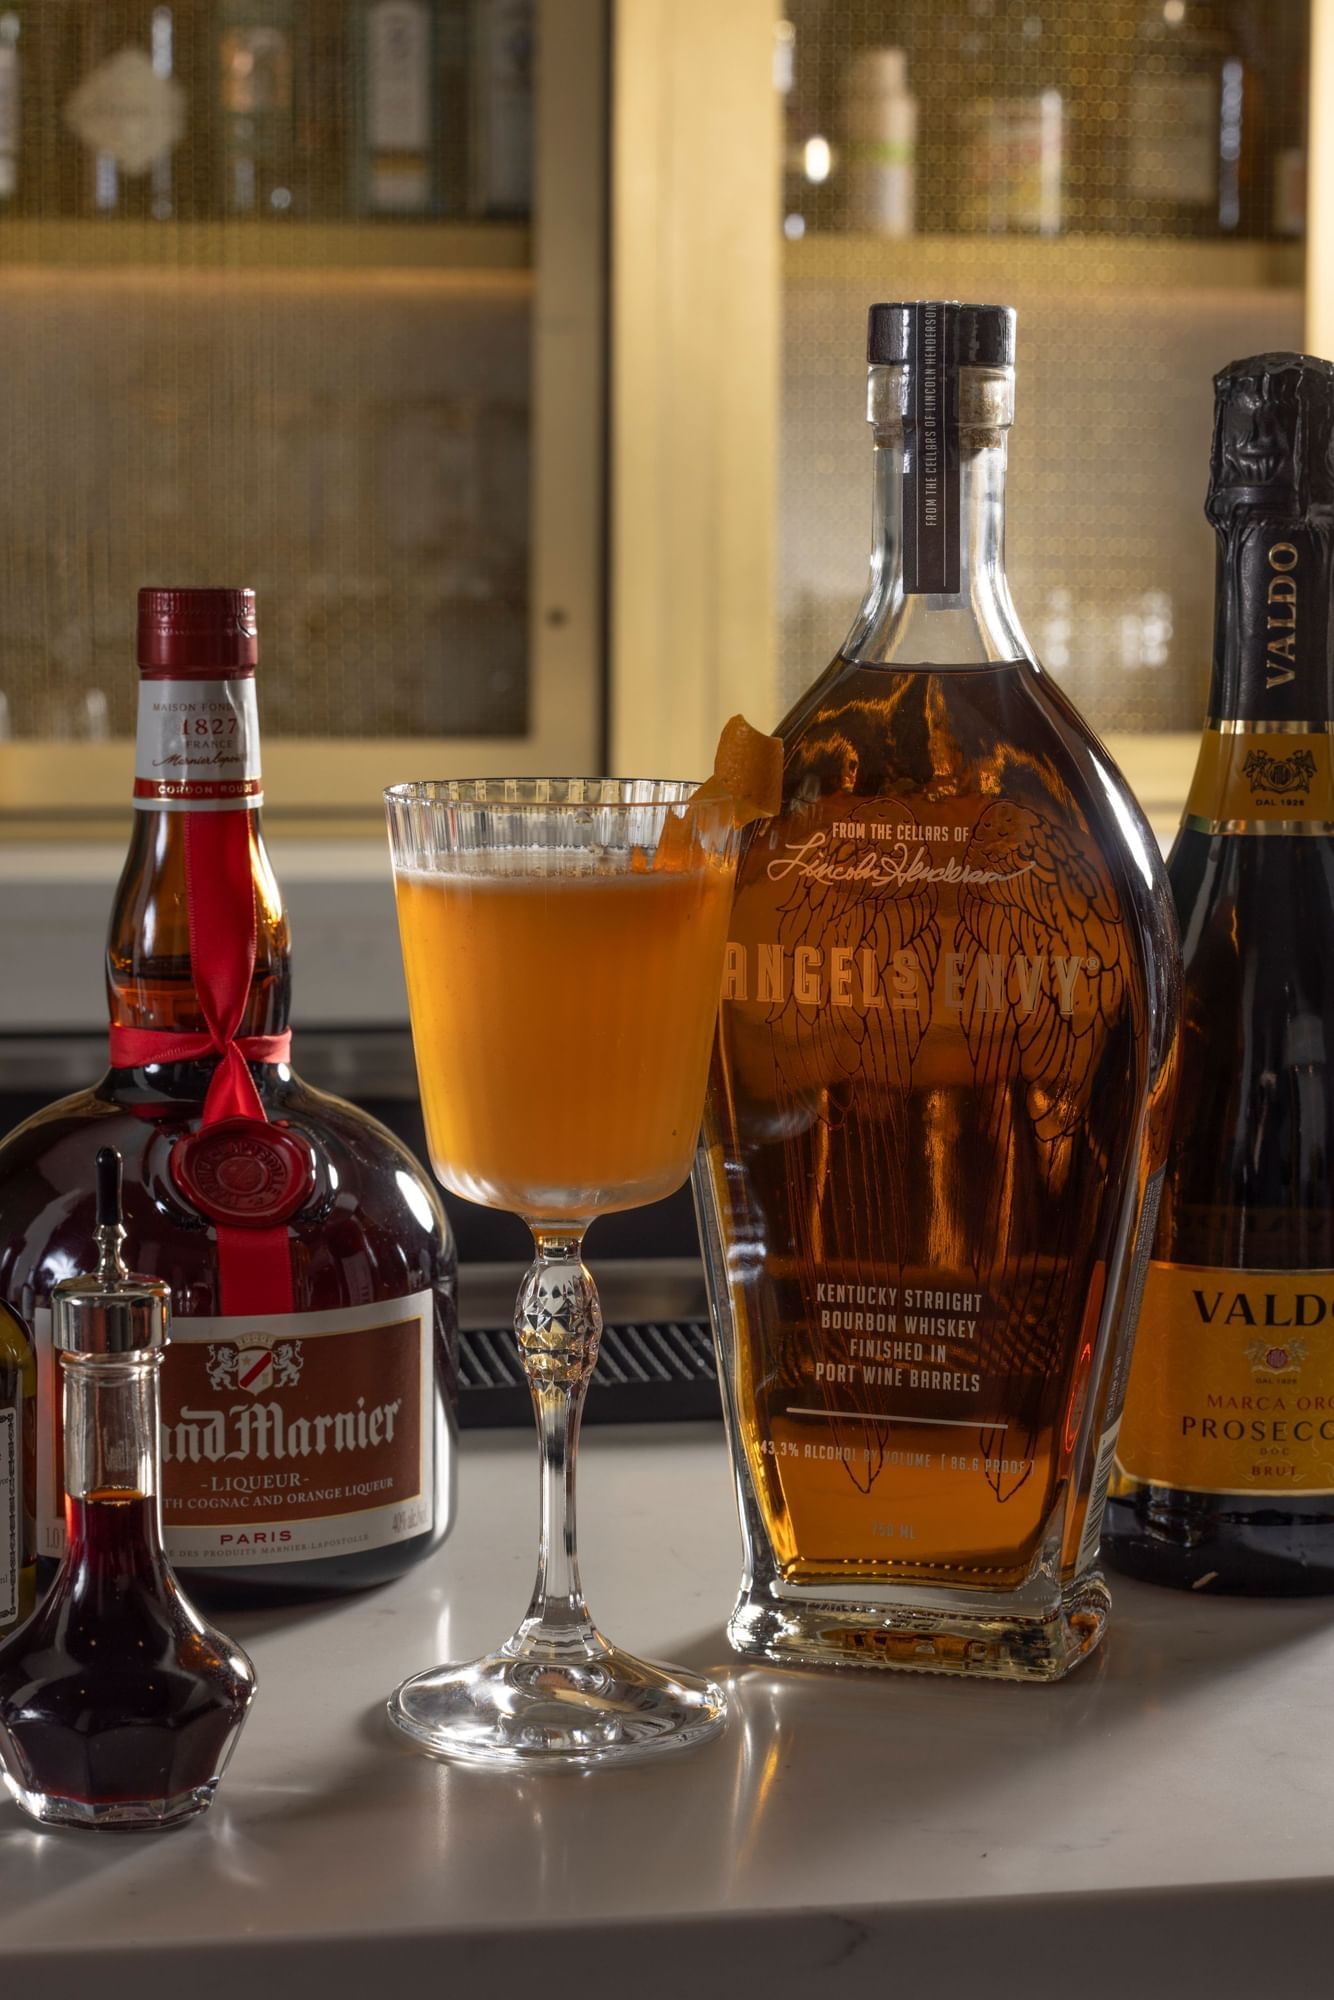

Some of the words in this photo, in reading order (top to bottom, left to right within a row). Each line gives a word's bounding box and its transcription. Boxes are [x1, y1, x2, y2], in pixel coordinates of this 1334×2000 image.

[924, 304, 937, 365] HENDERSON
[924, 367, 936, 411] LINCOLN
[924, 415, 937, 427] OF
[924, 431, 937, 473] CELLARS
[925, 477, 937, 495] THE
[924, 499, 937, 526] FROM
[1266, 541, 1299, 689] VALDO
[153, 703, 197, 713] MAISON
[182, 717, 238, 736] 1827
[186, 739, 233, 749] FRANCE
[832, 821, 866, 839] FROM
[870, 823, 892, 841] THE
[896, 824, 949, 842] CELLARS
[954, 826, 969, 842] OF
[816, 1283, 898, 1307] KENTUCKY
[904, 1289, 983, 1313] STRAIGHT
[1191, 1289, 1334, 1327] VALD
[821, 1310, 897, 1333] BOURBON
[904, 1315, 977, 1340] WHISKEY
[849, 1338, 923, 1361] FINISHED
[930, 1344, 947, 1363] IN
[815, 1362, 856, 1384] PORT
[862, 1365, 903, 1387] WINE
[909, 1369, 981, 1393] BARRELS
[1206, 1394, 1287, 1411] MARCA
[224, 1397, 399, 1464] Marnier
[760, 1439, 799, 1457] 43.3%
[804, 1444, 857, 1462] ALCOHOL
[863, 1448, 878, 1464] BY
[884, 1450, 931, 1468] VOLUME
[985, 1458, 1026, 1474] PROOF
[1251, 1465, 1298, 1477] BRUT
[187, 1496, 251, 1510] COGNAC
[252, 1495, 284, 1507] AND
[287, 1487, 342, 1504] ORANGE
[345, 1476, 395, 1497] LIQUEUR
[220, 1530, 292, 1546] PARIS
[203, 1548, 257, 1558] PRODUITS
